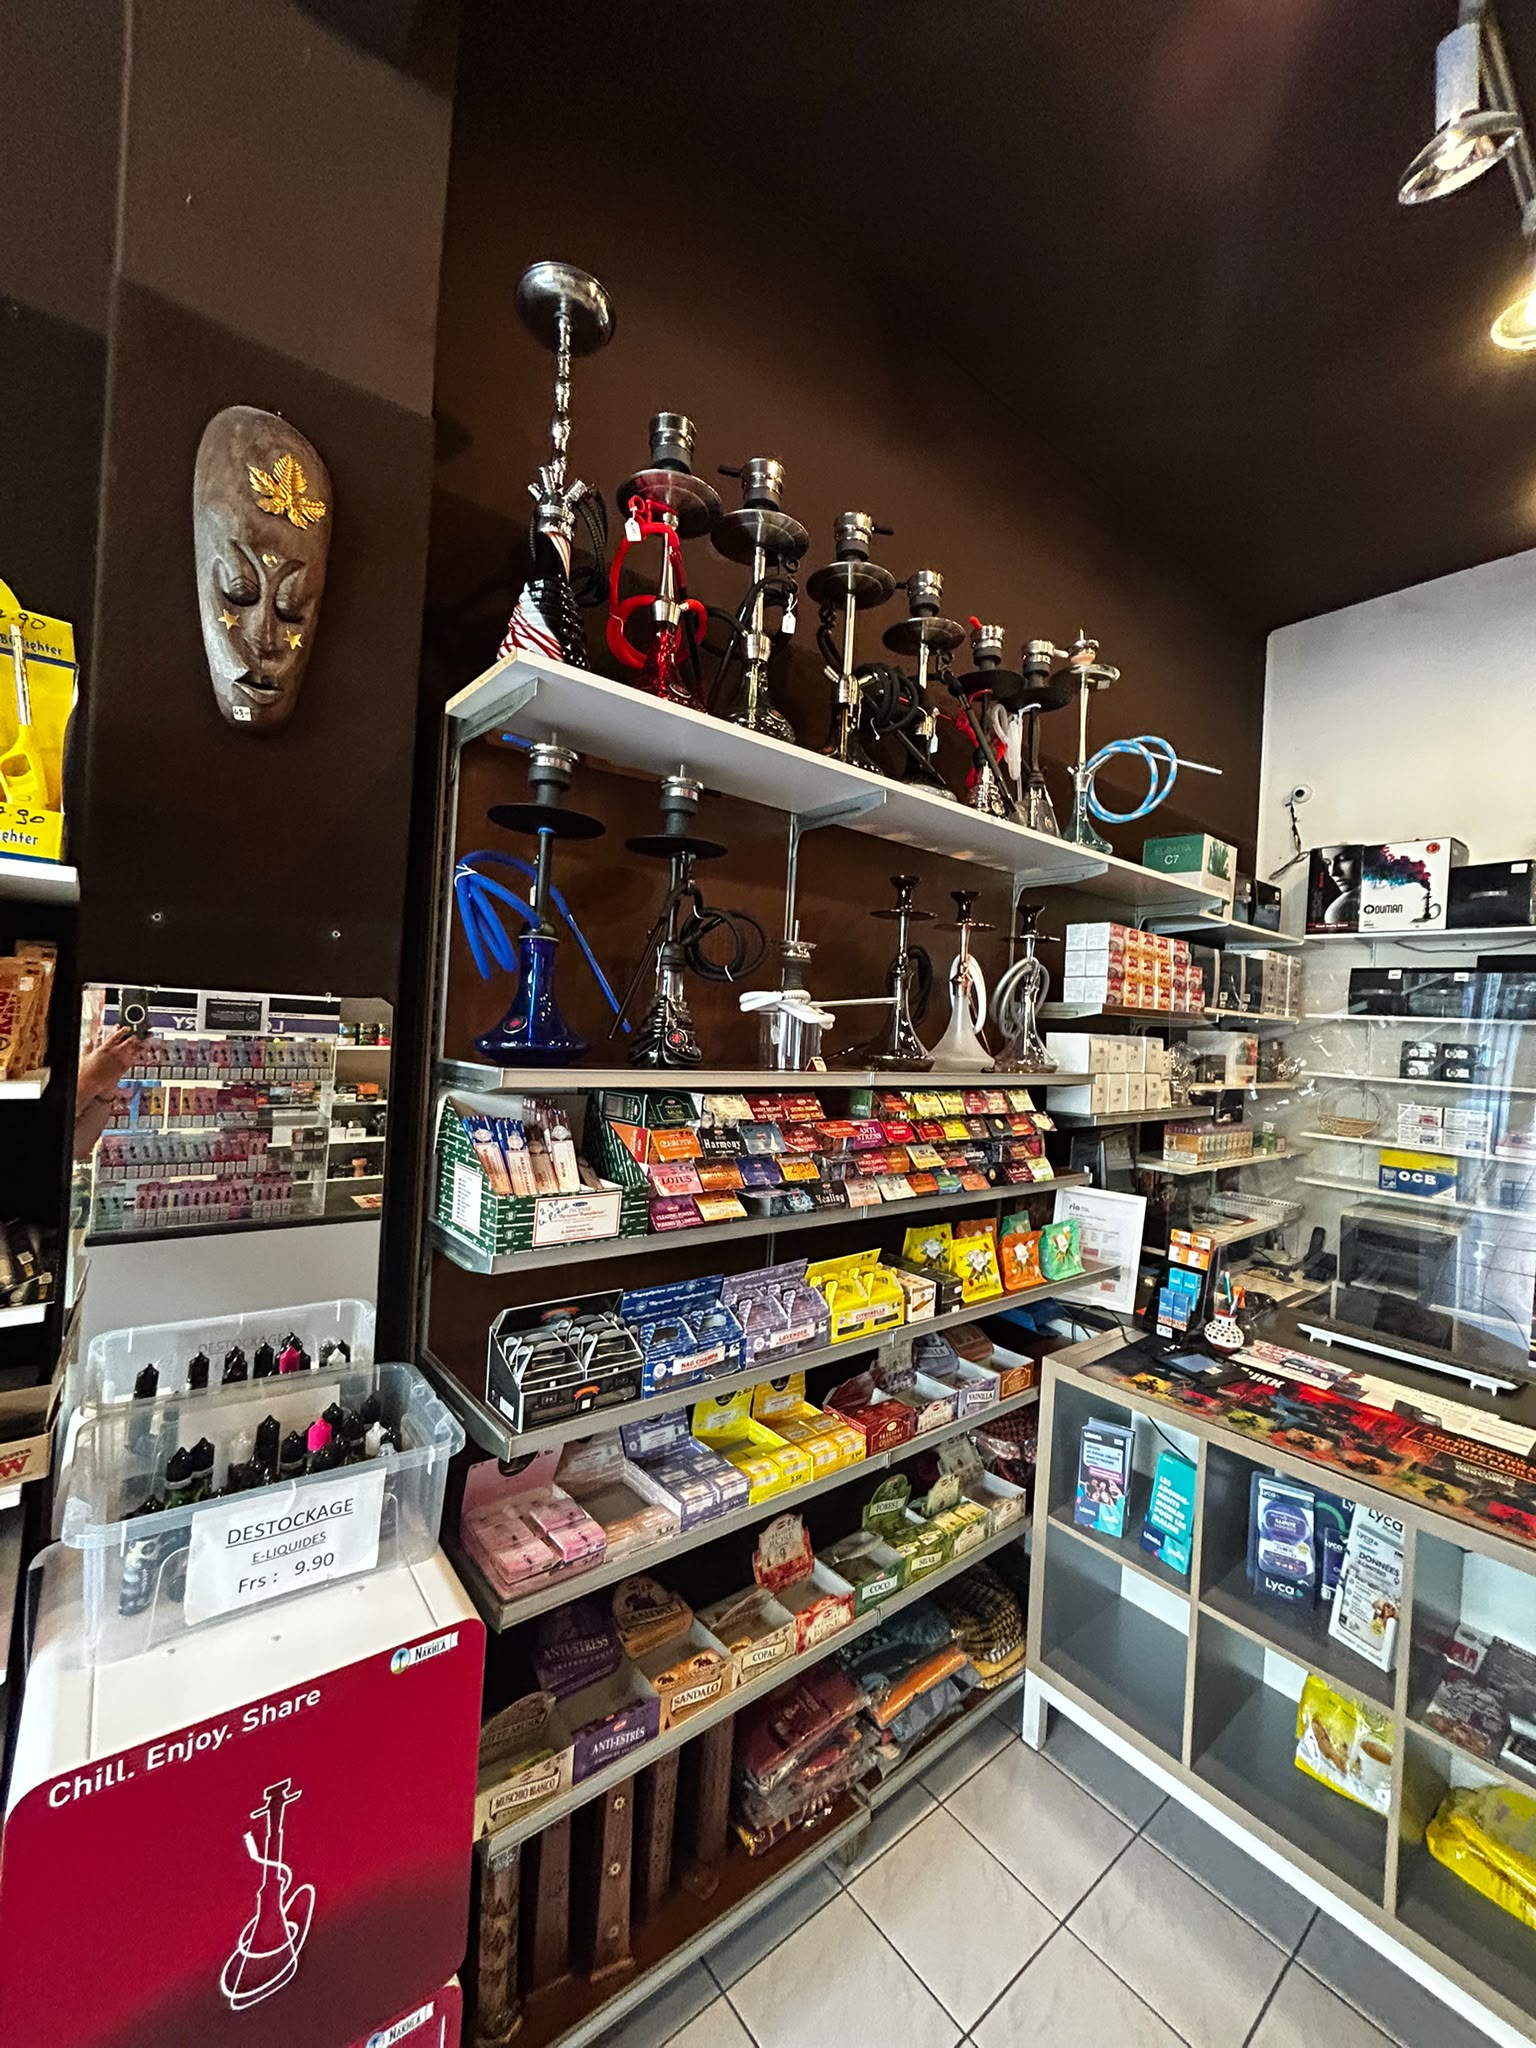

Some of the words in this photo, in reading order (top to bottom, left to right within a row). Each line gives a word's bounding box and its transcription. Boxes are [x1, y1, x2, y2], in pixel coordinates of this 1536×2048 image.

[1164, 854, 1180, 865] C7
[703, 1139, 741, 1150] Harmony
[661, 1174, 692, 1186] LOTUS
[1398, 1170, 1437, 1186] OCB
[779, 1328, 808, 1342] LAVENDER
[1342, 1498, 1355, 1512] Ly
[227, 1498, 354, 1547] DESTOCKAGE
[1368, 1508, 1404, 1533] Lyca
[252, 1531, 327, 1564] E-LIQUIDES
[238, 1575, 266, 1594] Frs
[295, 1552, 334, 1576] 9.90
[869, 1582, 891, 1595] COCO
[1265, 1577, 1295, 1596] Lyca
[620, 1606, 678, 1627] SANDAL
[414, 1641, 447, 1661] NAKHLA
[542, 1635, 610, 1660] ANTI-STRESS
[751, 1647, 777, 1662] COPAL
[673, 1682, 720, 1706] SANDALO
[49, 1759, 136, 1808] Chill.
[146, 1725, 233, 1771] Enjoy.
[241, 1689, 321, 1732] Share
[591, 1726, 646, 1756] ANTI-ESTRÉS
